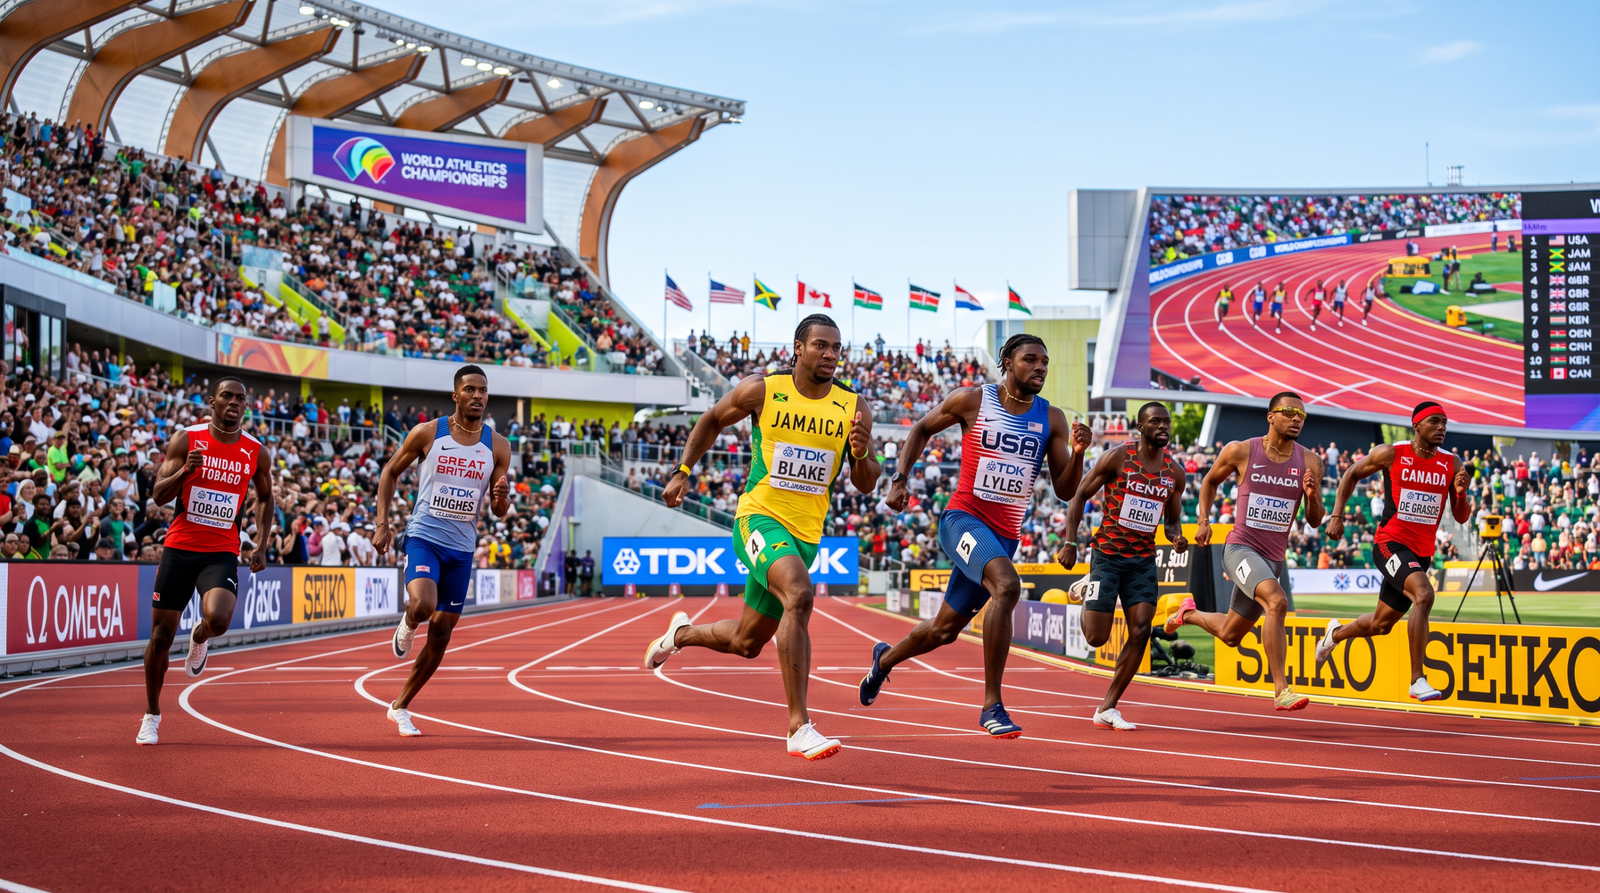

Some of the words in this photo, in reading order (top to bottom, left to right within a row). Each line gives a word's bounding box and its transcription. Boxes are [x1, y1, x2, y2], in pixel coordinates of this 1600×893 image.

[401, 152, 445, 169] WORLD
[445, 158, 508, 175] ATHLETICS
[401, 165, 508, 189] CHAMPIONSHIPS
[1530, 236, 1538, 246] 1
[1567, 235, 1589, 245] USA
[1530, 249, 1538, 259] 2
[1567, 249, 1591, 259] JAM
[1530, 262, 1538, 272] 3
[1530, 276, 1538, 285] 4
[1530, 289, 1538, 299] 5
[1567, 288, 1590, 299] GBR
[1531, 302, 1539, 313] 6
[1568, 302, 1590, 312] GBR
[1531, 315, 1539, 325] 7
[1568, 315, 1590, 325] KEN
[1531, 329, 1539, 339] 8
[1531, 342, 1540, 352] 9
[1530, 355, 1543, 365] 10
[1530, 369, 1543, 379] 11
[1569, 369, 1592, 379] CAN
[771, 411, 845, 440] JAMAICA
[980, 429, 1041, 459] USA
[438, 455, 486, 471] GREAT
[794, 447, 827, 463] TDK
[202, 455, 242, 473] RINIDAD
[243, 463, 250, 475] &
[436, 465, 485, 481] BRITAIN
[777, 460, 826, 482] BLAKE
[997, 462, 1026, 477] TDK
[201, 467, 242, 485] TOBAGO
[982, 474, 1023, 493] LYLES
[1250, 473, 1299, 488] CANADA
[1401, 467, 1447, 487] CANADA
[448, 486, 474, 498] TDK
[1126, 480, 1168, 498] KENYA
[206, 491, 233, 504] TDK
[433, 496, 475, 512] HUGHES
[1138, 498, 1160, 511] TDK
[1264, 497, 1290, 509] TDK
[1414, 492, 1437, 503] TDK
[192, 501, 234, 519] TOBAGO
[1248, 506, 1260, 518] DE
[1261, 508, 1292, 523] GRASSE
[1399, 501, 1411, 513] DE
[1128, 508, 1153, 523] RENA
[752, 539, 760, 555] 4
[960, 539, 970, 555] 5
[639, 548, 727, 575] TDK
[303, 573, 347, 621] SEIKO
[373, 577, 390, 609] TDK
[1088, 583, 1095, 597] 3
[54, 582, 124, 643] OMEGA
